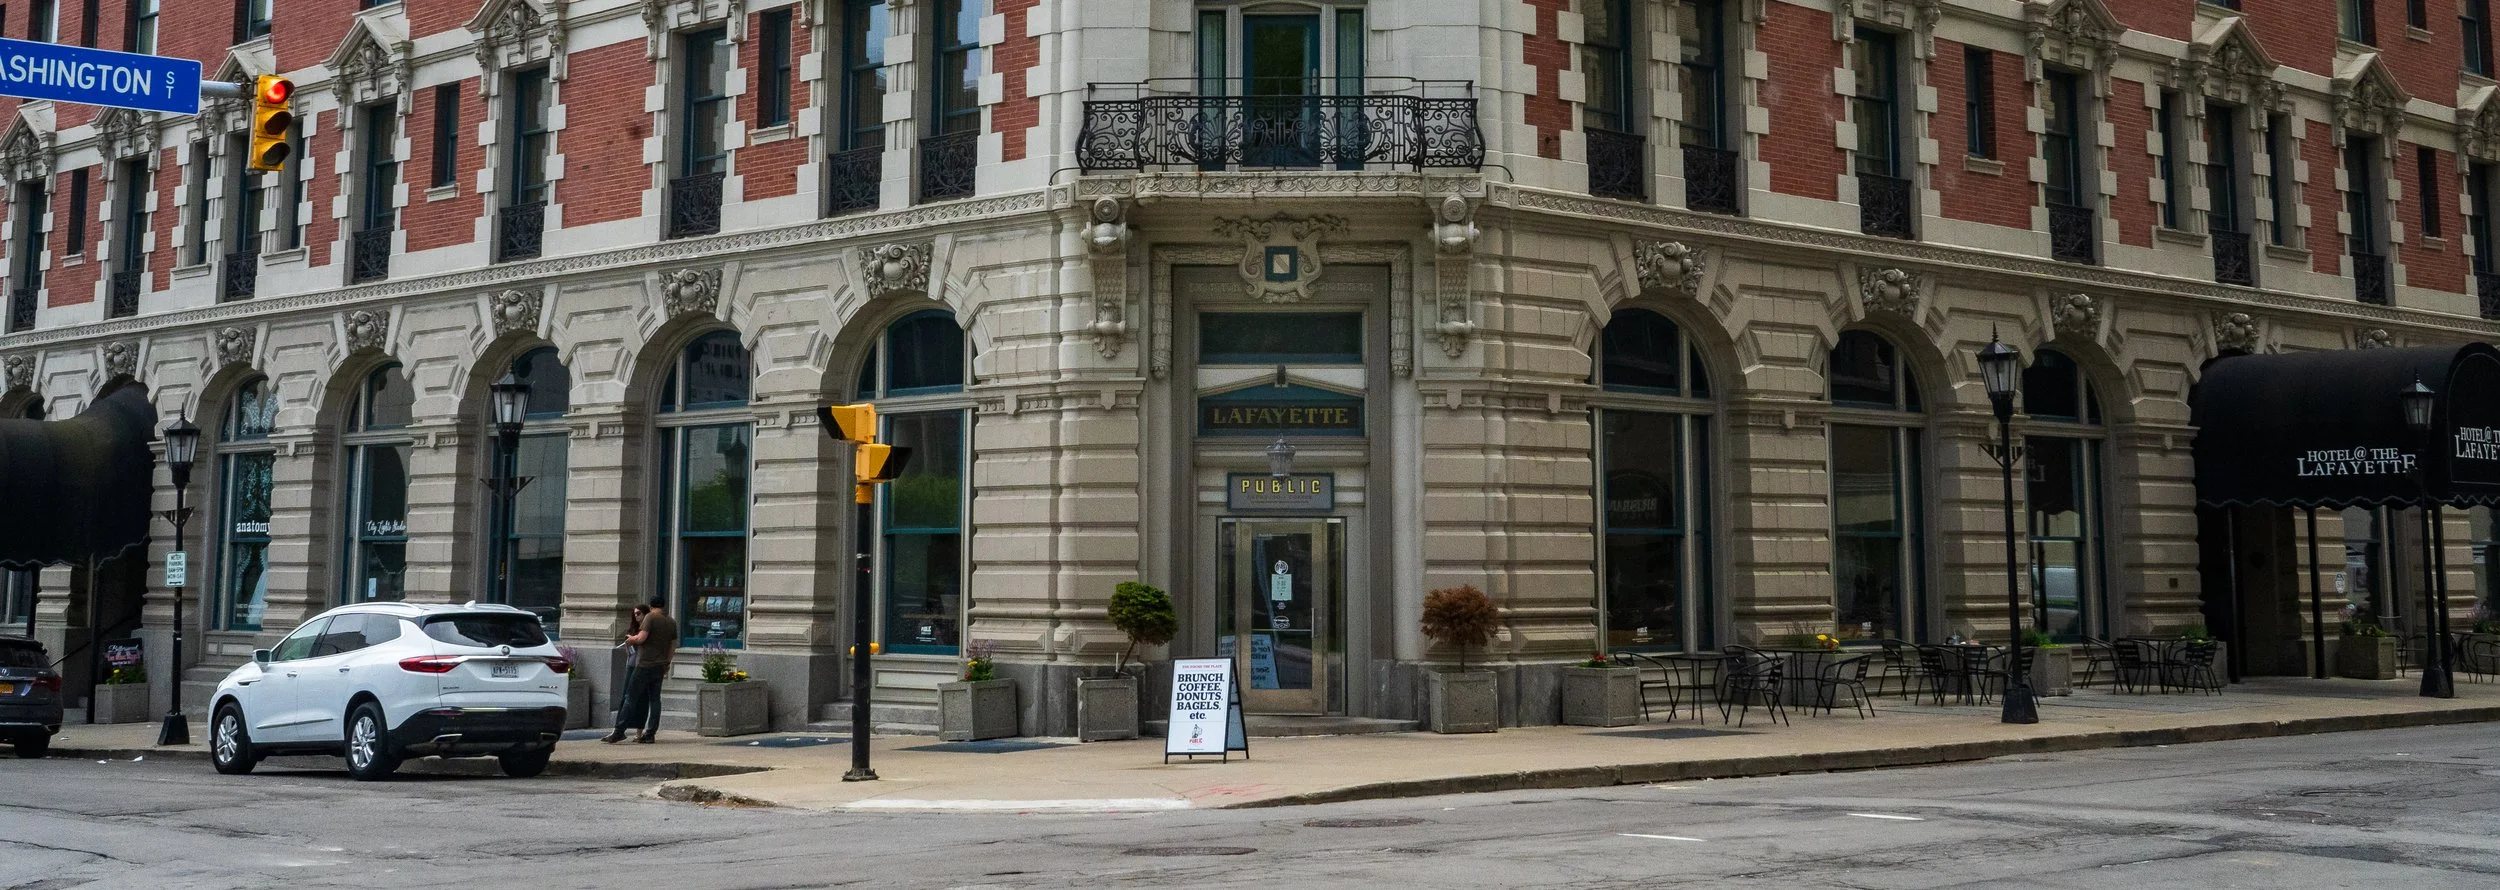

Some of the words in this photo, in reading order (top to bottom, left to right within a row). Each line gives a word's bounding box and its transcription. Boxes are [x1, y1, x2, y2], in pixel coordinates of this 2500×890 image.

[1213, 406, 1349, 424] LAFAYETTE
[2370, 447, 2399, 460] THE
[2297, 453, 2418, 477] LAFAYETTE
[1241, 479, 1321, 494] PUBLIC
[236, 520, 271, 536] anatomy
[1177, 673, 1225, 682] BRUNCH,
[1178, 683, 1222, 691] COFFEE,
[1176, 692, 1224, 701] DONUTS,
[1176, 702, 1222, 711] BAGELS,
[1189, 711, 1207, 720] etc.
